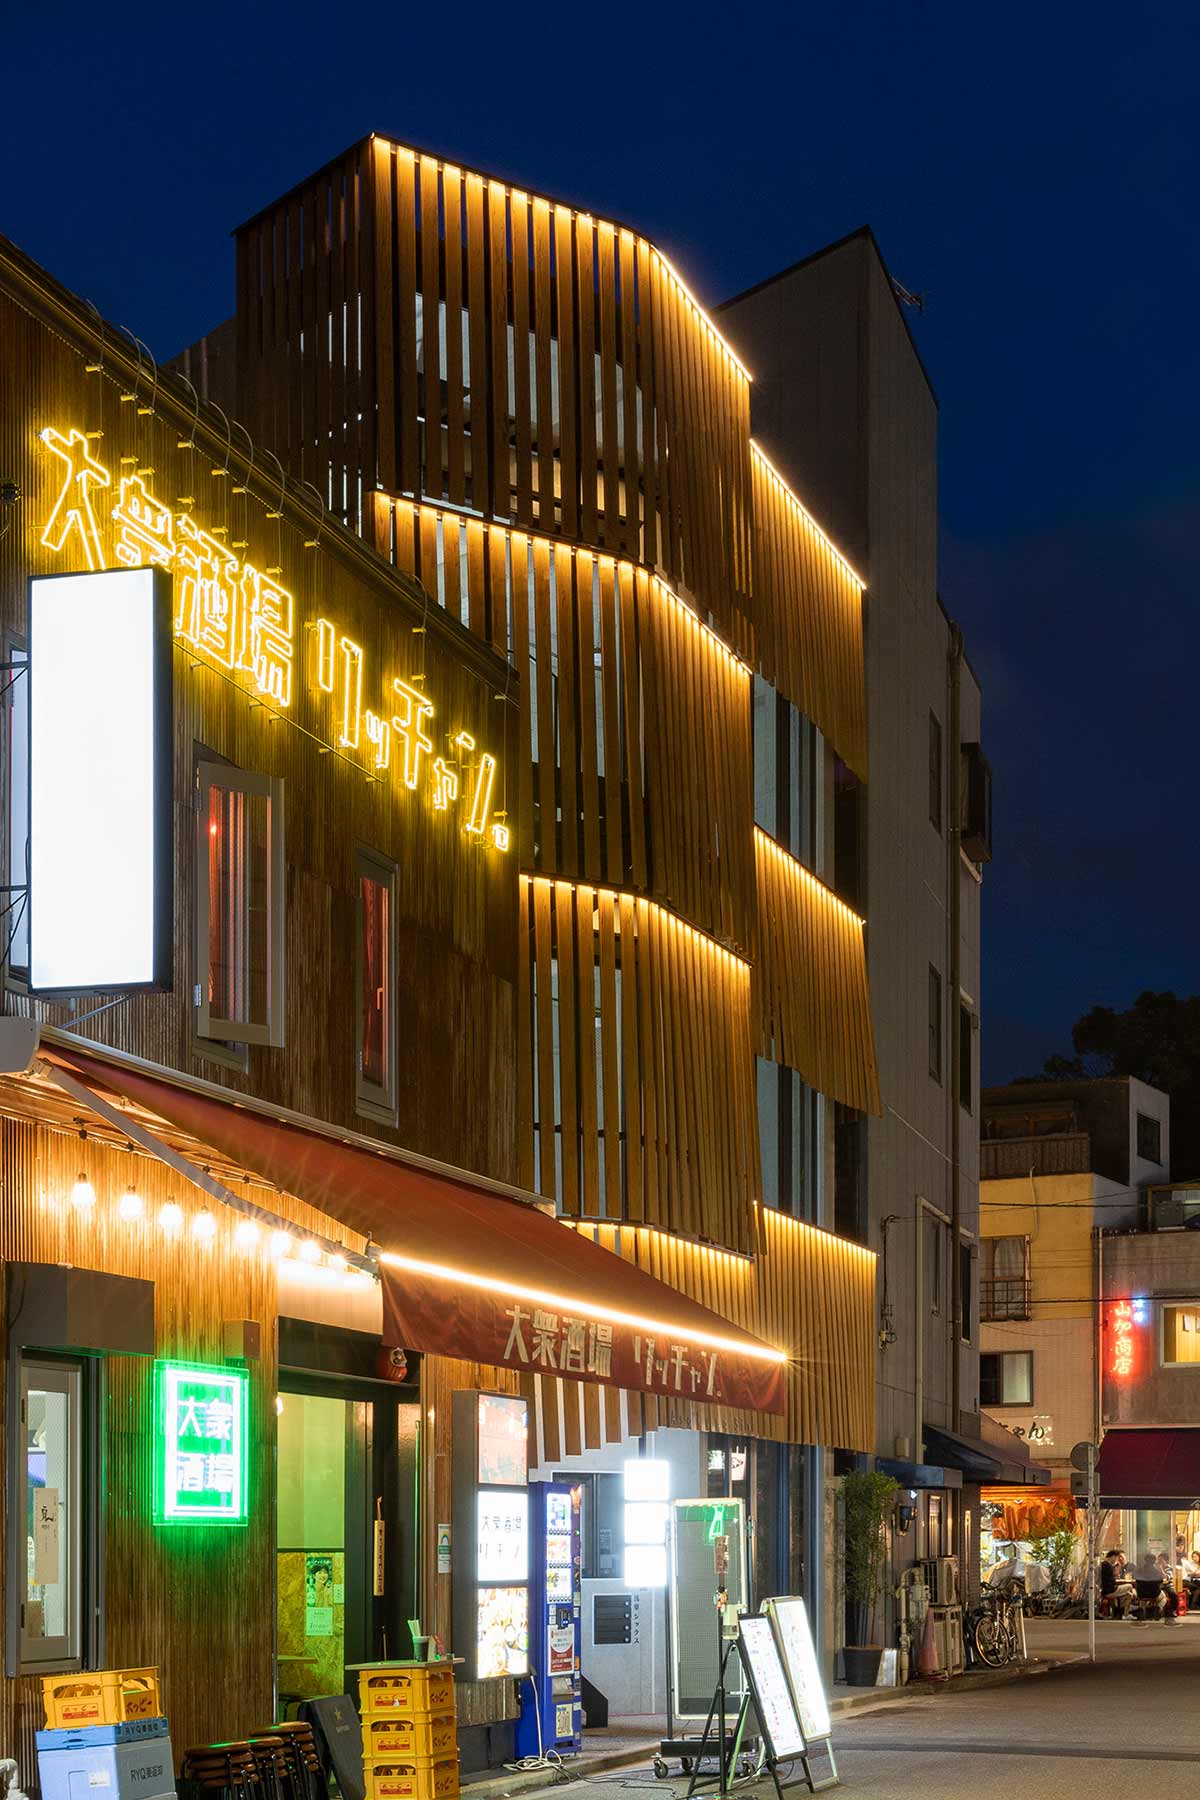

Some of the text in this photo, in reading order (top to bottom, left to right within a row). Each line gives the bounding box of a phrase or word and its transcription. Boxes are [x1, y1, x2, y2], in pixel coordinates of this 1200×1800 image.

[503, 1304, 614, 1378] 大衆酒場
[177, 1396, 234, 1440] 大衆
[999, 1421, 1045, 1440] ゃん
[177, 1452, 234, 1493] 酒場
